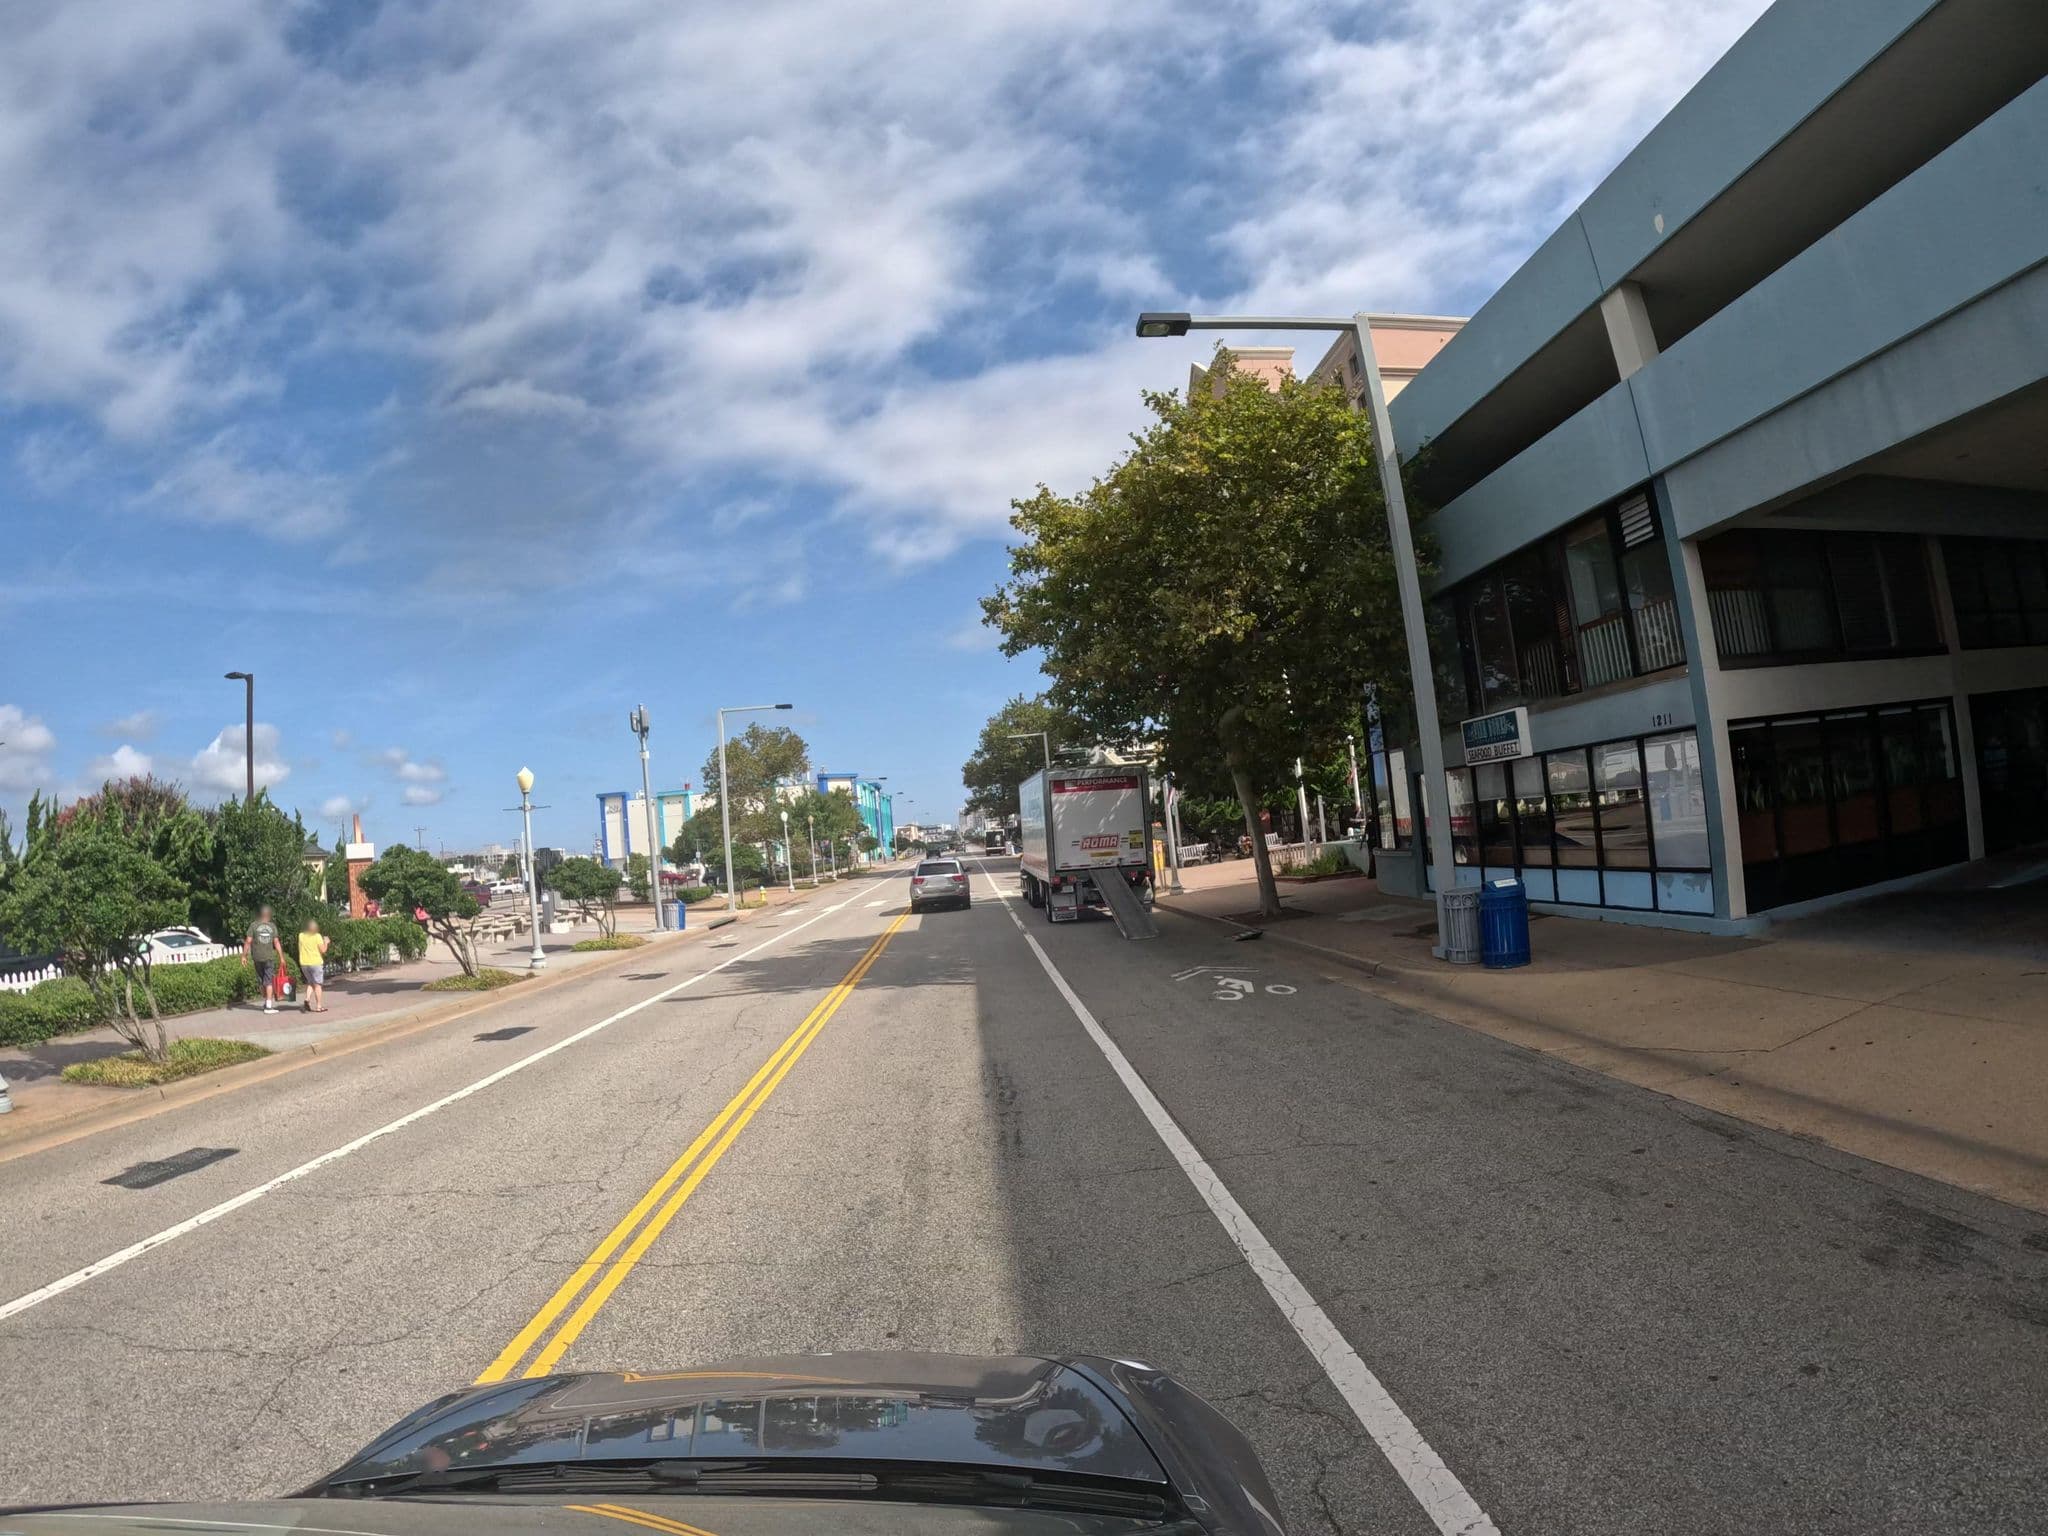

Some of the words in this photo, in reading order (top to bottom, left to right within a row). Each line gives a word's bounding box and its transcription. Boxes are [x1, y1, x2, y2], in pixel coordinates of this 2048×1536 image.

[1652, 713, 1672, 727] 1211
[1468, 747, 1492, 760] SEAFOOD
[1494, 742, 1518, 756] BUFFET
[1076, 777, 1128, 786] PERFORMANCE
[1082, 836, 1118, 849] ROMA
